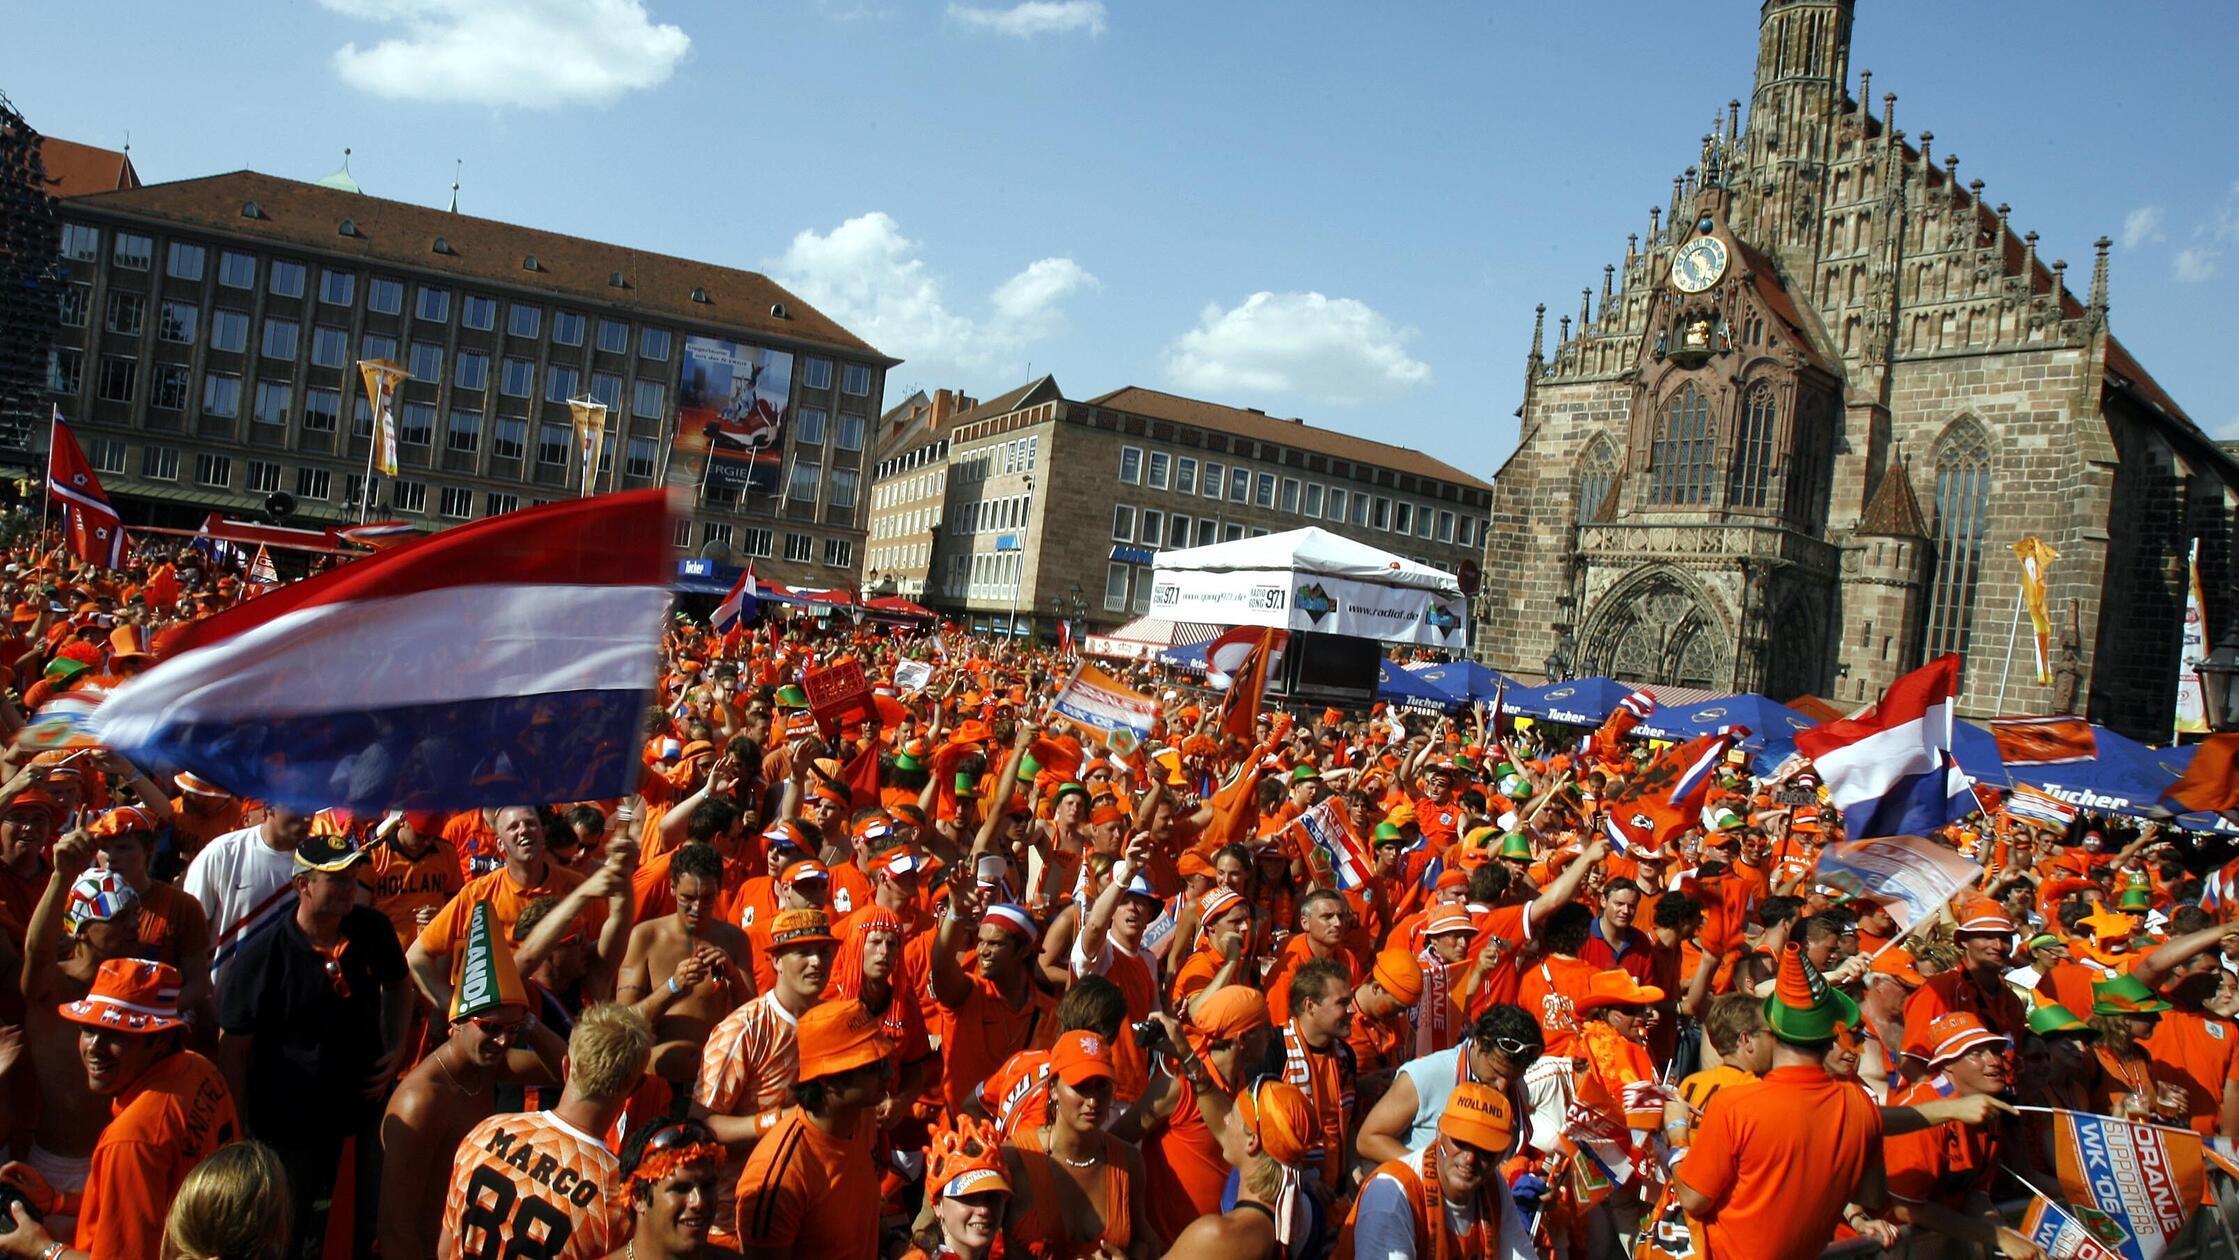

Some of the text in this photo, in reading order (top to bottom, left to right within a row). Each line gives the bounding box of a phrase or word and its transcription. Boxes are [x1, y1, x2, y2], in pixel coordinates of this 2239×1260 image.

[1164, 586, 1180, 605] 97.1
[1265, 590, 1286, 609] 97.1
[1406, 695, 1445, 709] Tucher
[1547, 708, 1586, 723] Tucher
[2042, 782, 2129, 810] Tucher
[459, 904, 492, 1013] HOLLAND!
[1457, 1096, 1503, 1119] HOLLAND
[485, 1126, 599, 1208] MARCO
[2081, 1122, 2122, 1215] WK '06
[2104, 1120, 2155, 1236] SUPPORTERS
[2133, 1125, 2182, 1233] ORANJE
[1426, 1185, 1439, 1208] WE
[462, 1164, 572, 1260] 88
